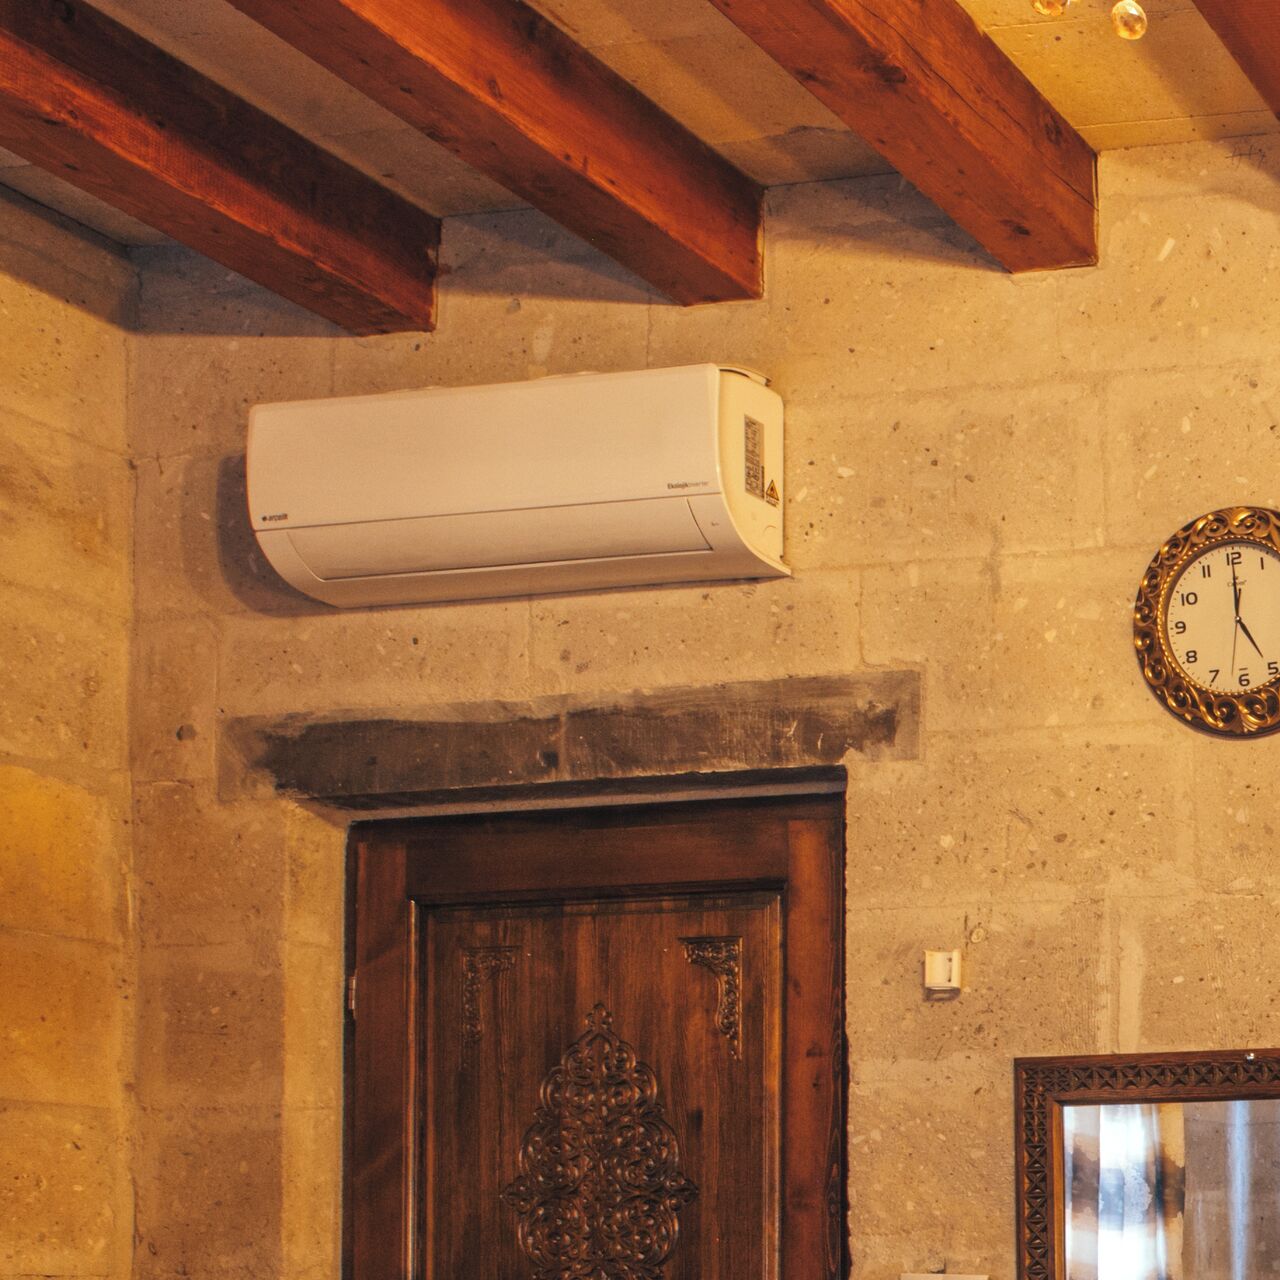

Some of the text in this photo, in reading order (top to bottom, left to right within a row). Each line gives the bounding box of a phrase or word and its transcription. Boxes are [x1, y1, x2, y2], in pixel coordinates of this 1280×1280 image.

[1226, 551, 1243, 566] 12
[1260, 556, 1265, 570] 1
[1202, 564, 1211, 578] 11
[1181, 592, 1198, 606] 10
[1174, 621, 1187, 634] 9
[1186, 650, 1198, 664] 8
[1267, 661, 1279, 675] 5
[1209, 669, 1220, 684] 7
[1238, 673, 1250, 687] 6
